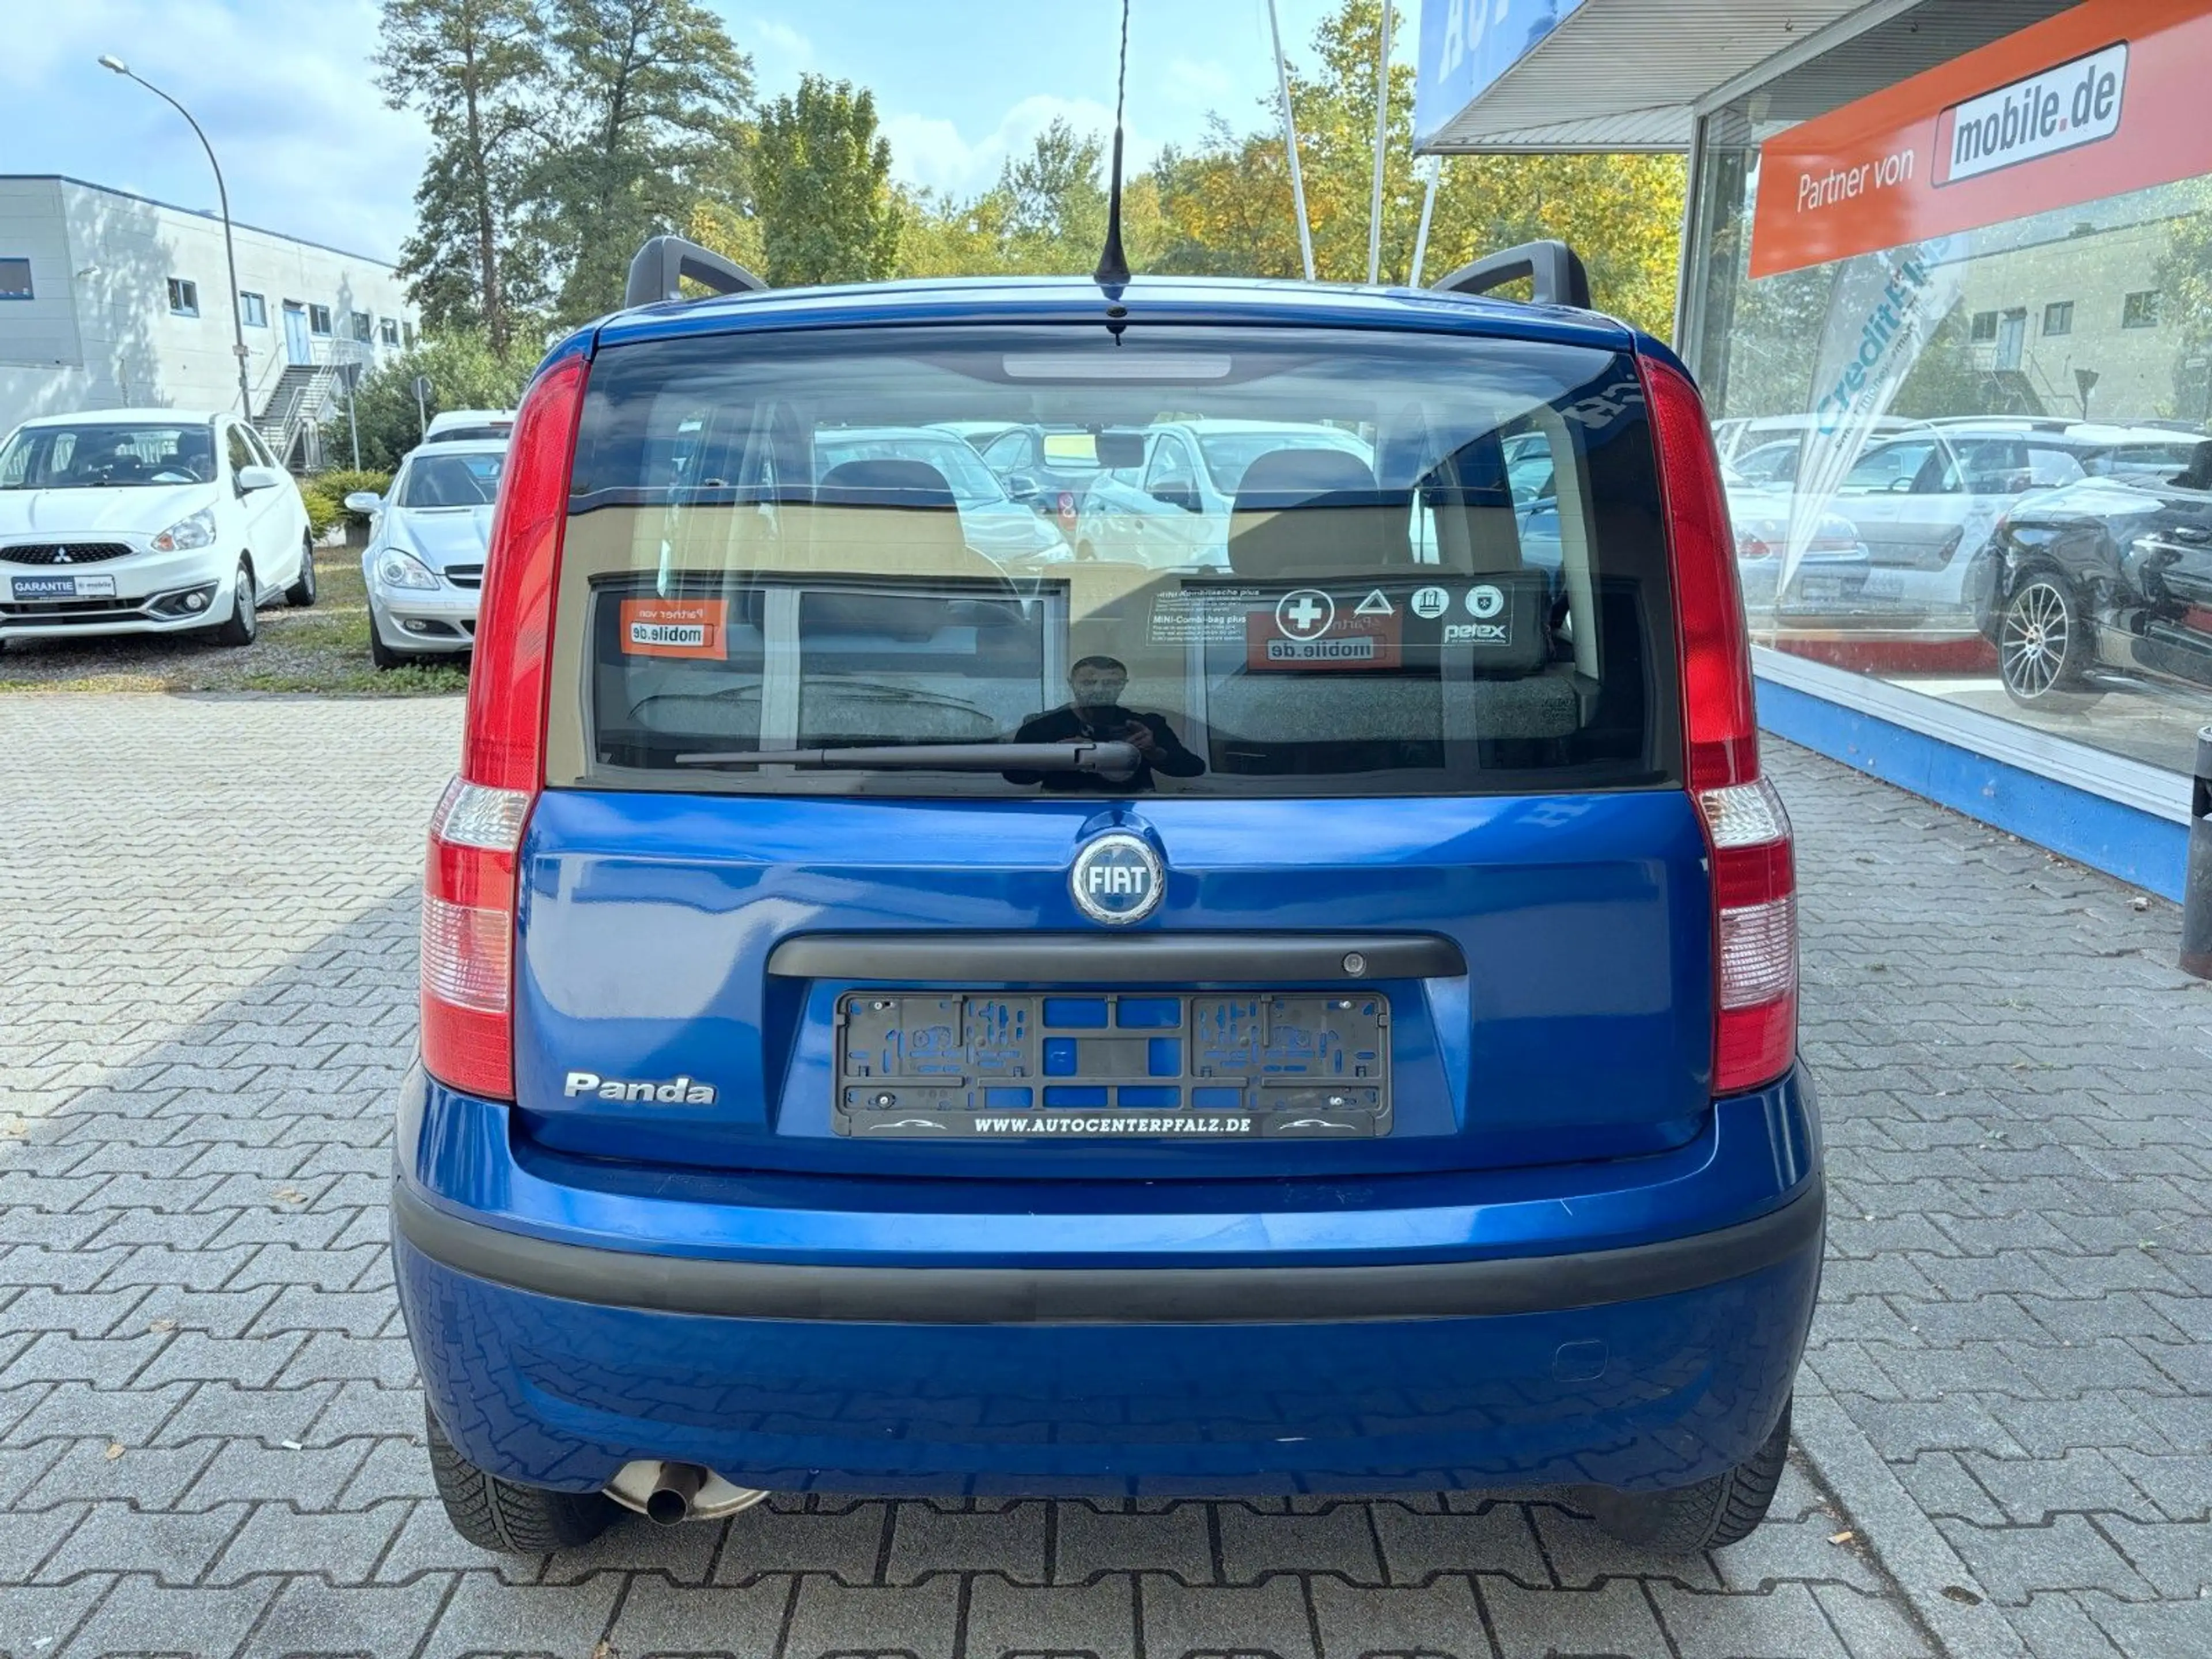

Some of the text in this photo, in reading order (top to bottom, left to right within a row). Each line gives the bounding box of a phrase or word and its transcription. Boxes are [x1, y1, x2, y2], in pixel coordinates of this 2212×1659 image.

[1955, 65, 2116, 164] mobile.de
[1797, 149, 1914, 213] Partner von
[15, 582, 74, 592] GARANTIE
[1227, 614, 1247, 624] plus
[1089, 866, 1146, 893] FIAT
[564, 1072, 714, 1104] Panda
[975, 1119, 1251, 1132] WWW.AUTOCENTERPFALZ.DE
